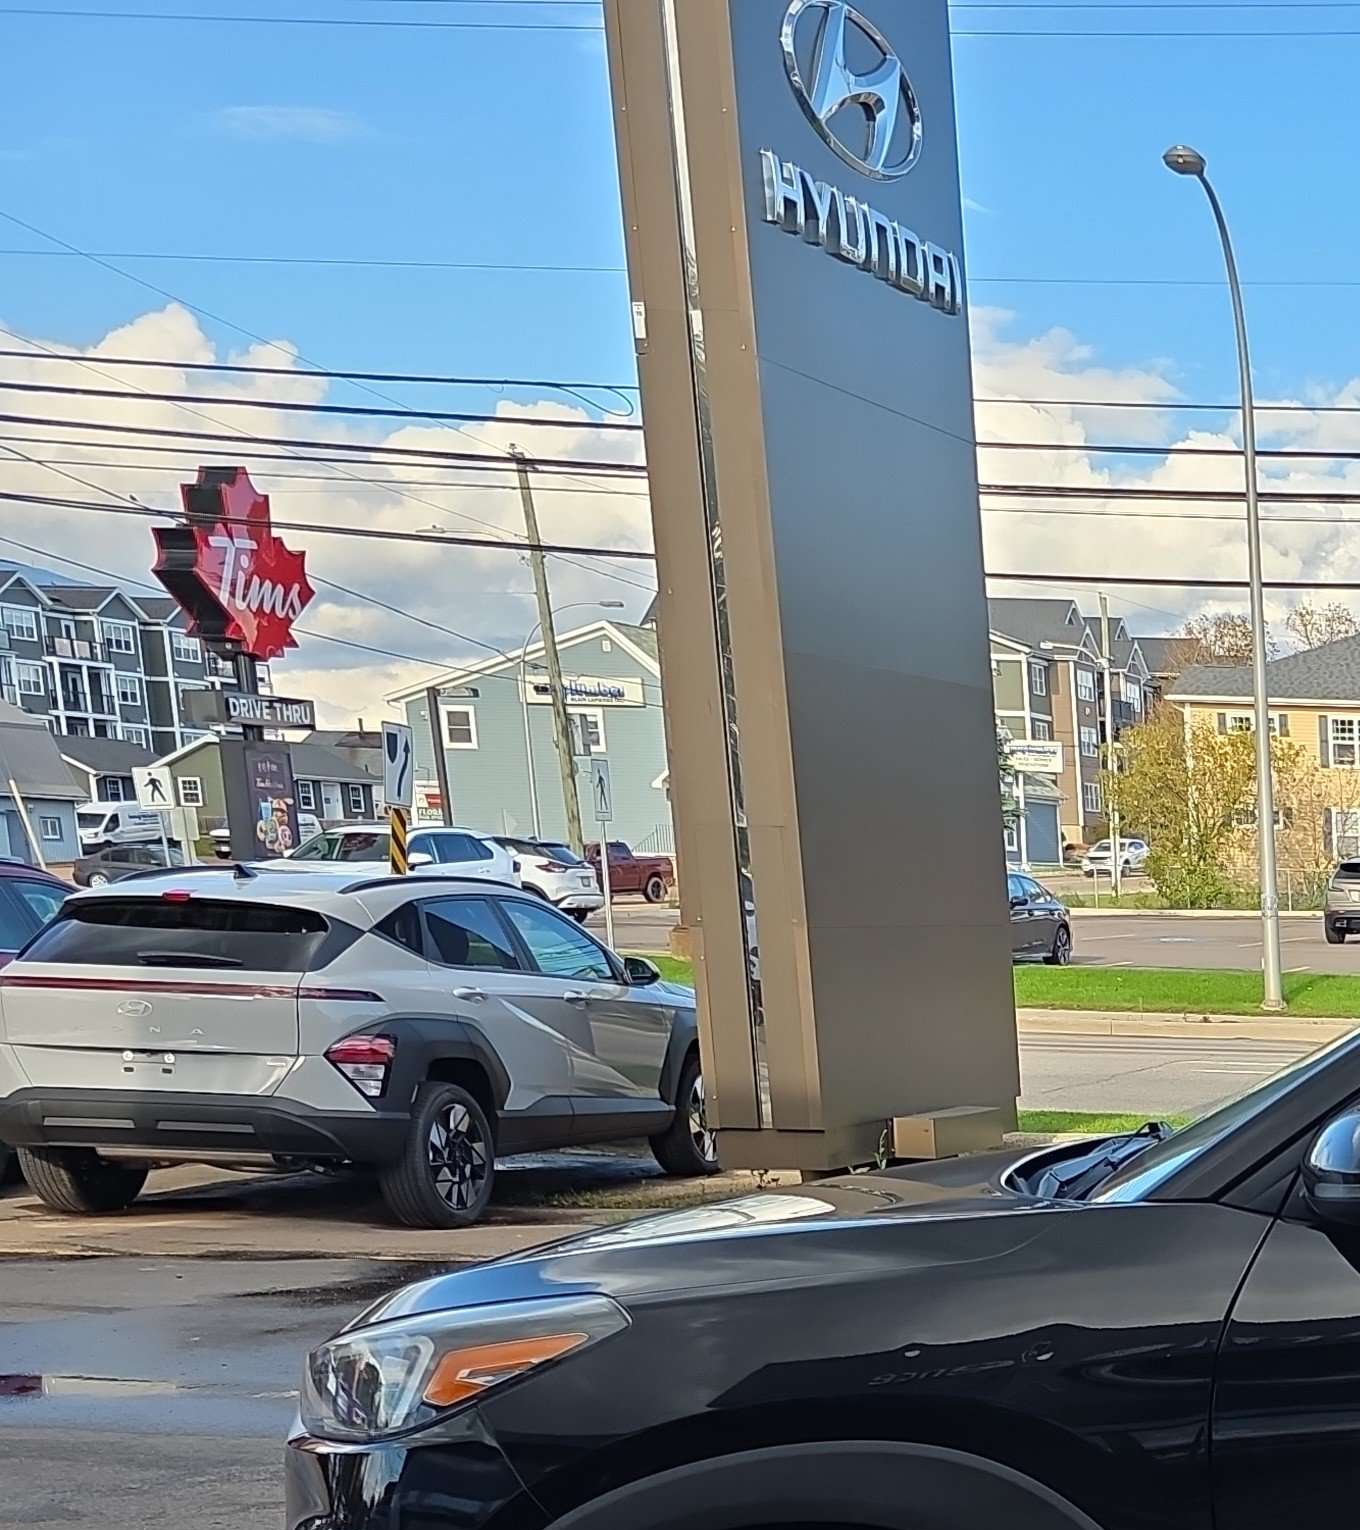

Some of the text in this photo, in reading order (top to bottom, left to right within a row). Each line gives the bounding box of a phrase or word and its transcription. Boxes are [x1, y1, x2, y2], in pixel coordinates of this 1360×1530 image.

[760, 149, 962, 315] HYUNDAI
[208, 535, 302, 621] Tims
[228, 697, 311, 724] DRIVE THRU
